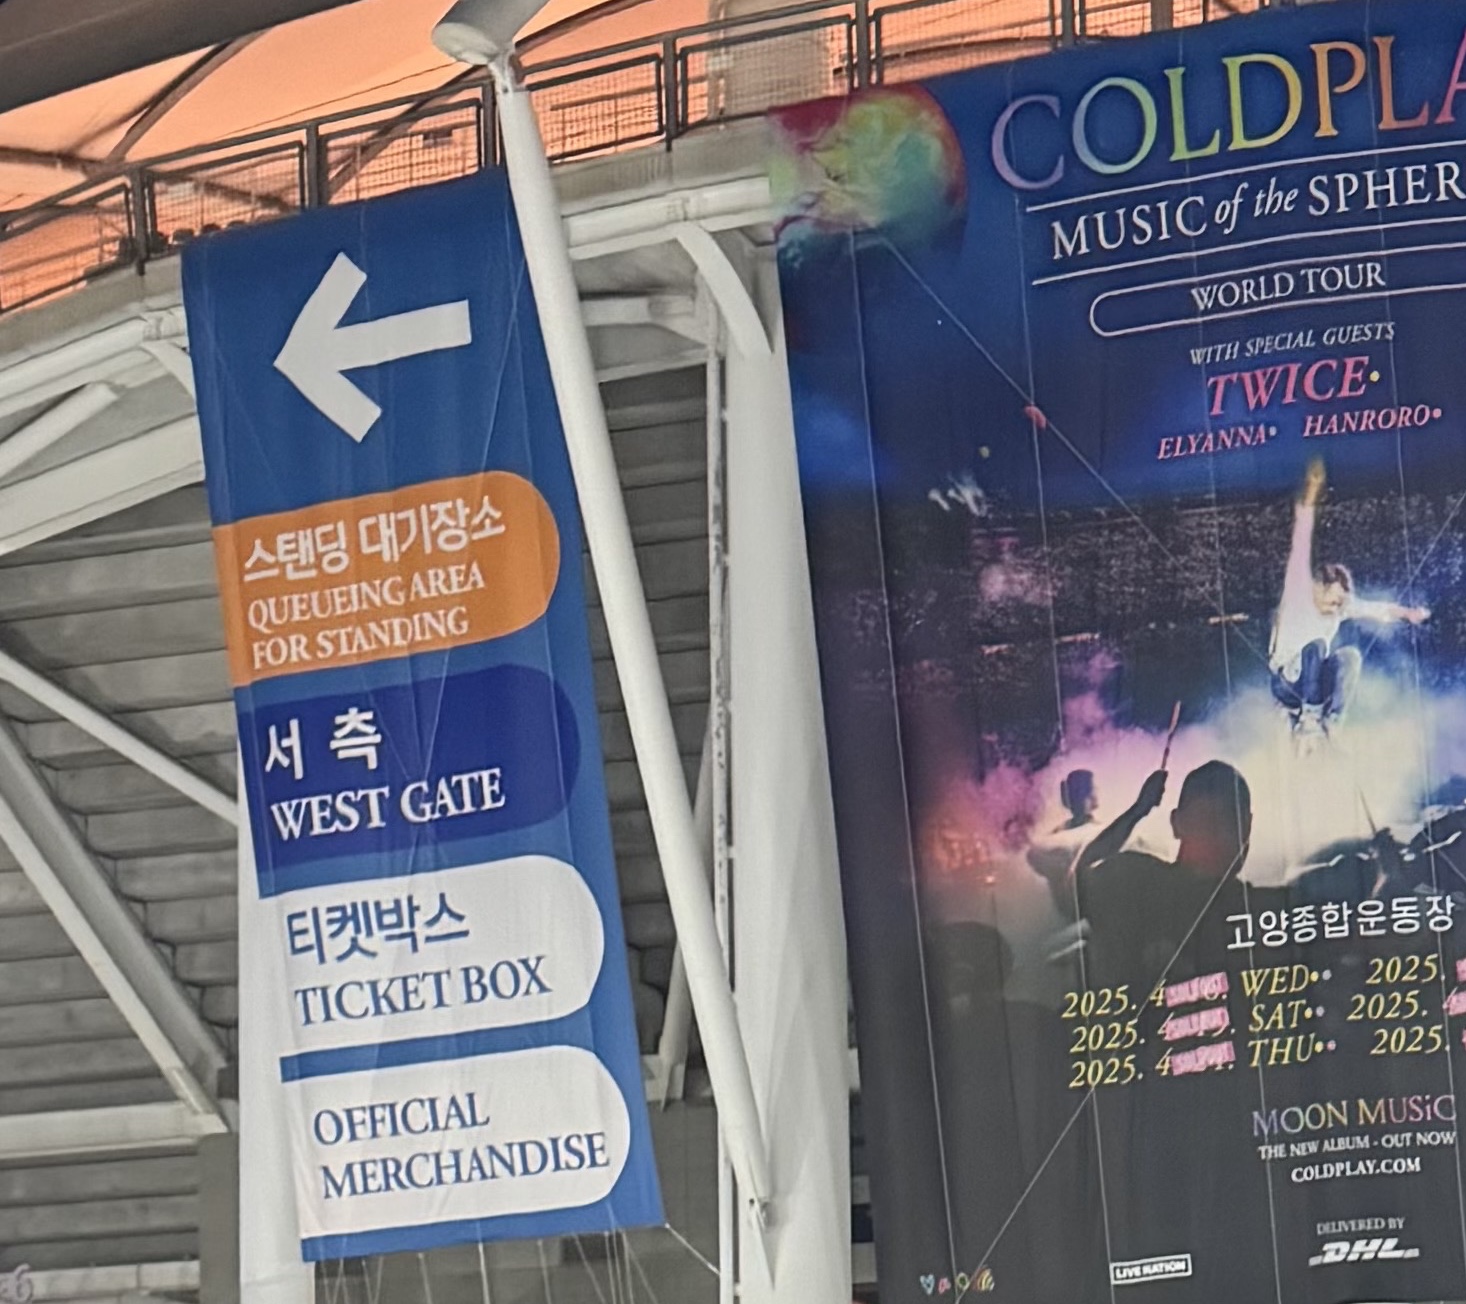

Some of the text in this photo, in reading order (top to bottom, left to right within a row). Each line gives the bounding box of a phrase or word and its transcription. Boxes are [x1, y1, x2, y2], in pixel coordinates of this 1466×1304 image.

[1051, 196, 1208, 260] MUSIC
[1214, 183, 1250, 236] of
[1254, 176, 1299, 217] the
[1190, 262, 1386, 311] WORLD TOUR
[1190, 321, 1396, 365] WITH SPECIAL GUESTS
[1207, 356, 1370, 417] TWICE
[1157, 404, 1431, 460] ELYANNA HANRORO
[243, 495, 505, 583] 스탠딩 대기장소
[247, 563, 485, 630] QUEUEING AREA
[252, 606, 469, 669] FOR STANDING
[270, 767, 505, 841] WEST GATE
[286, 892, 470, 965] 티켓박스
[1225, 895, 1457, 950] 고양종합운동장
[294, 955, 552, 1027] TICKET BOX
[1240, 964, 1309, 997] WED
[1248, 999, 1306, 1032] SAT
[1247, 1033, 1316, 1067] THU
[313, 1092, 491, 1146] OFFICIAL
[1252, 1100, 1349, 1137] MOON
[1258, 1145, 1287, 1160] THE
[1290, 1141, 1320, 1157] NEW
[1322, 1134, 1370, 1152] ALBUM
[1381, 1132, 1412, 1149] OUT
[1416, 1131, 1457, 1146] NOW
[322, 1132, 611, 1200] MERCHANDISE
[1291, 1157, 1421, 1183] COLDPLAY.COM
[1318, 1237, 1412, 1265] DHL
